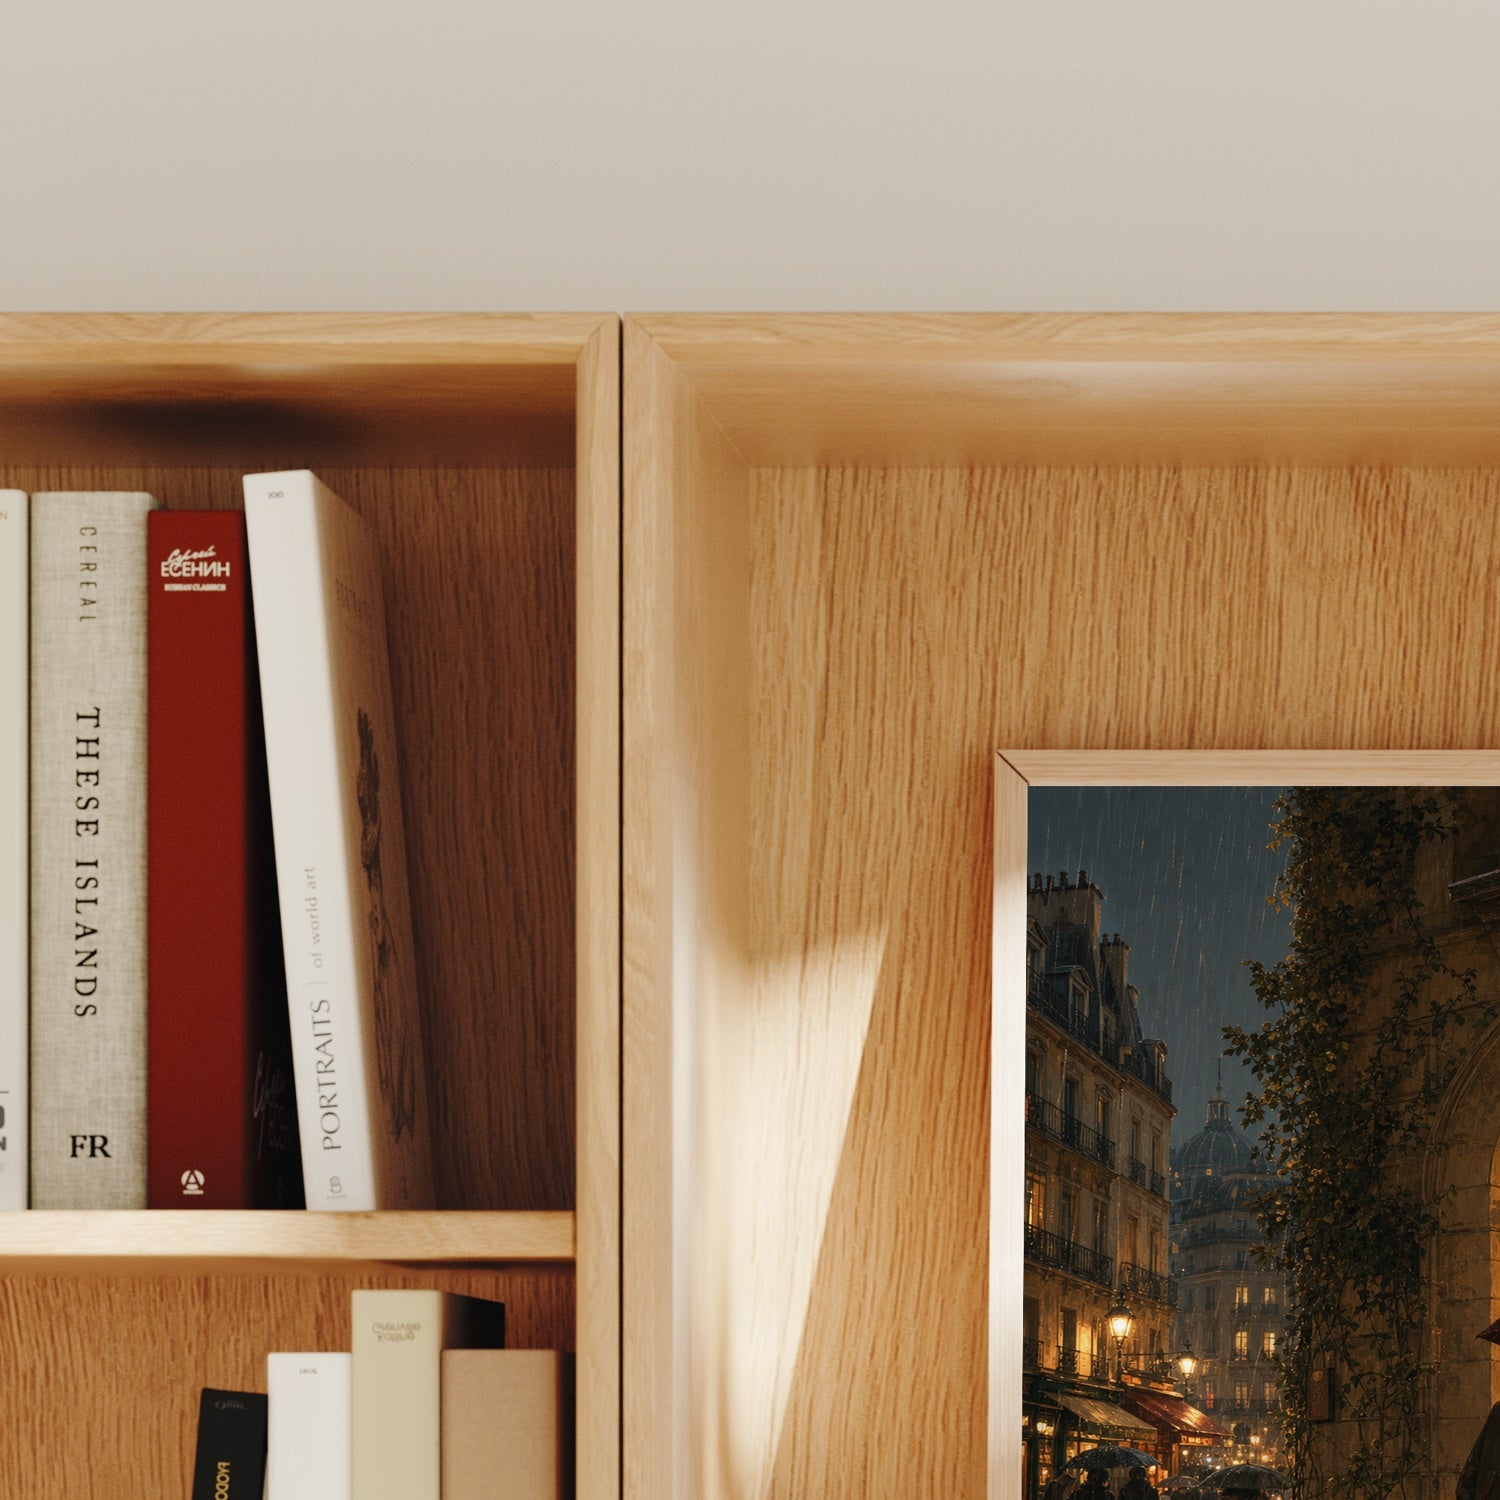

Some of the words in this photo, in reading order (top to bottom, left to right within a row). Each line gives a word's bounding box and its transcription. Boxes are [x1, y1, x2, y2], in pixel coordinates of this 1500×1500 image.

[79, 526, 98, 623] CEREAL
[160, 561, 231, 578] ЕСЕНИН
[76, 706, 101, 837] THESE
[304, 866, 317, 891] art
[74, 858, 99, 1018] ISLANDS
[305, 896, 322, 945] world
[313, 951, 324, 969] of
[310, 998, 342, 1151] PORTRAITS
[69, 1134, 113, 1158] FR
